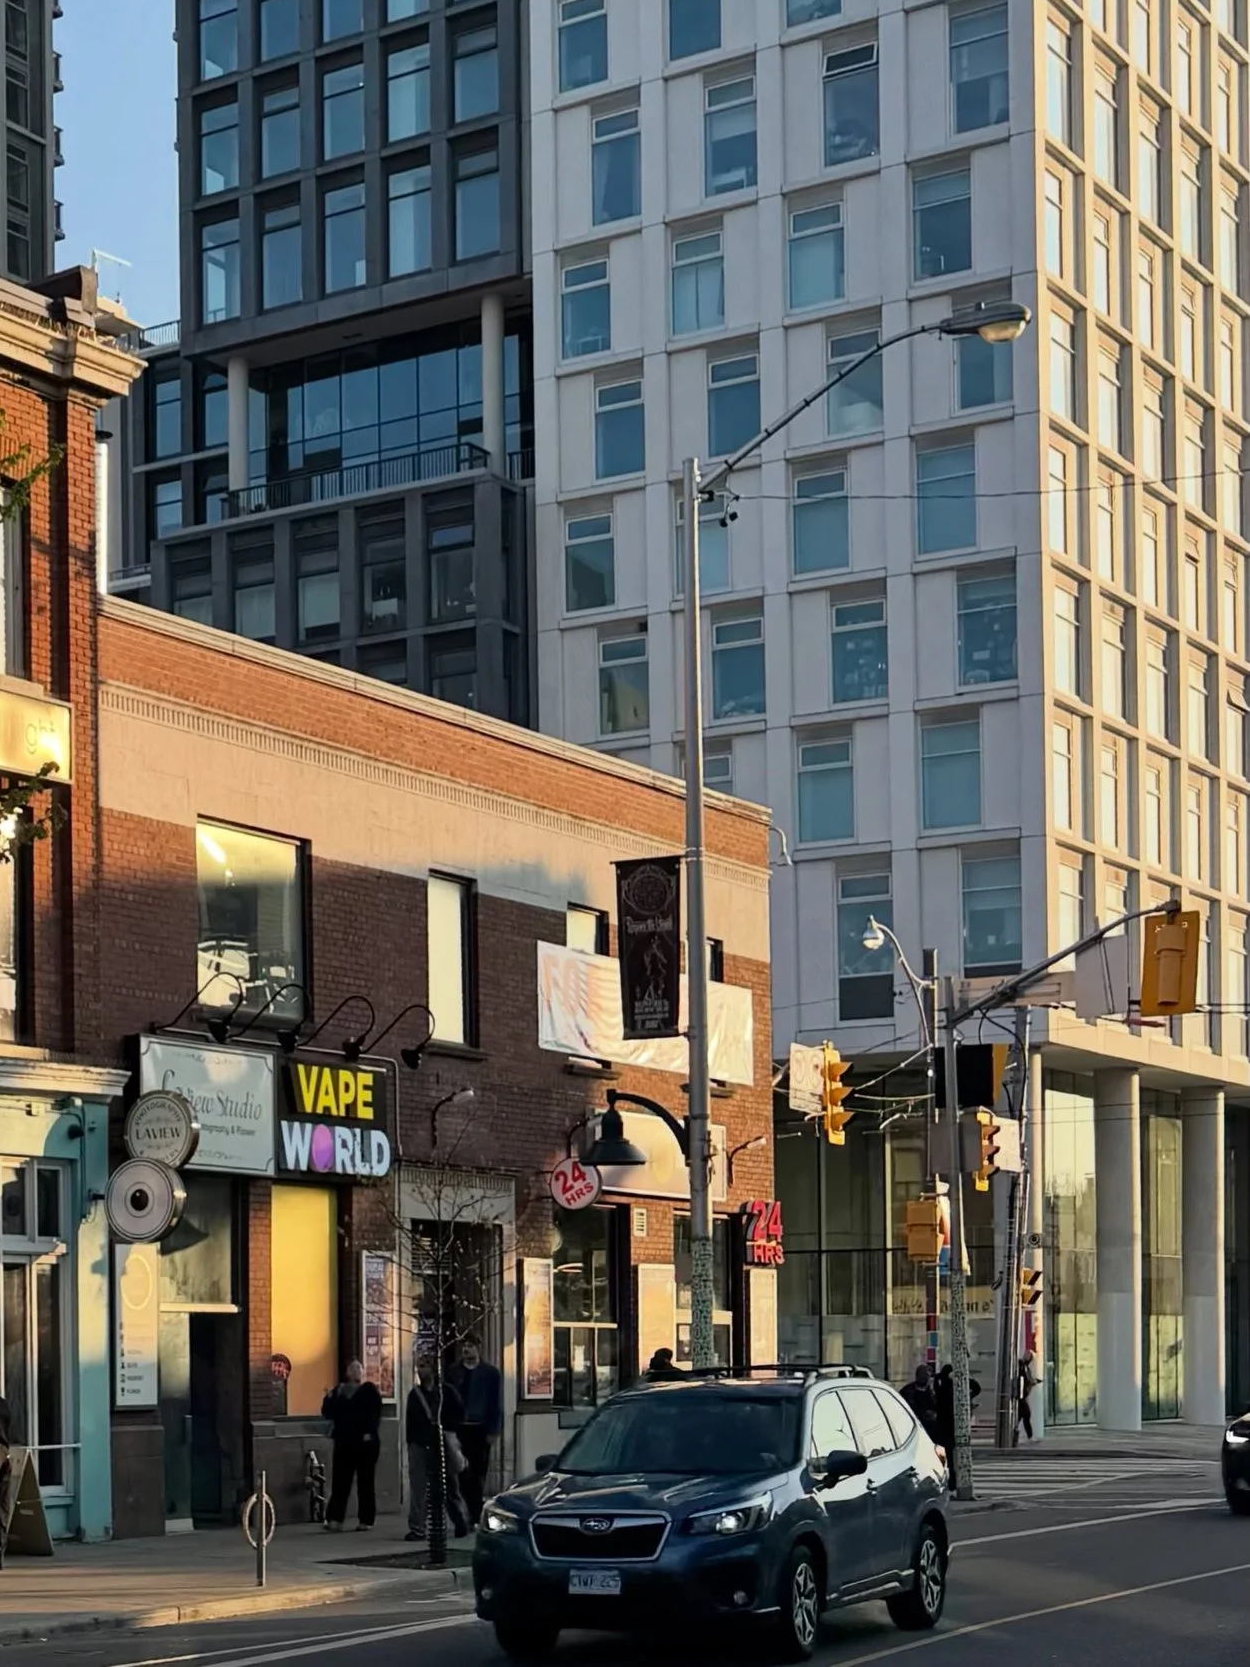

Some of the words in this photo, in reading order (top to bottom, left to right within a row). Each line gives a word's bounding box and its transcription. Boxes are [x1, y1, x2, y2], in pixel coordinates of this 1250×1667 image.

[216, 1090, 262, 1121] Studio
[297, 1063, 374, 1120] VAPE
[280, 1120, 391, 1177] WORLD
[554, 1161, 587, 1195] 24
[564, 1183, 594, 1207] HRS
[751, 1199, 784, 1242] 24
[753, 1242, 785, 1265] HRS
